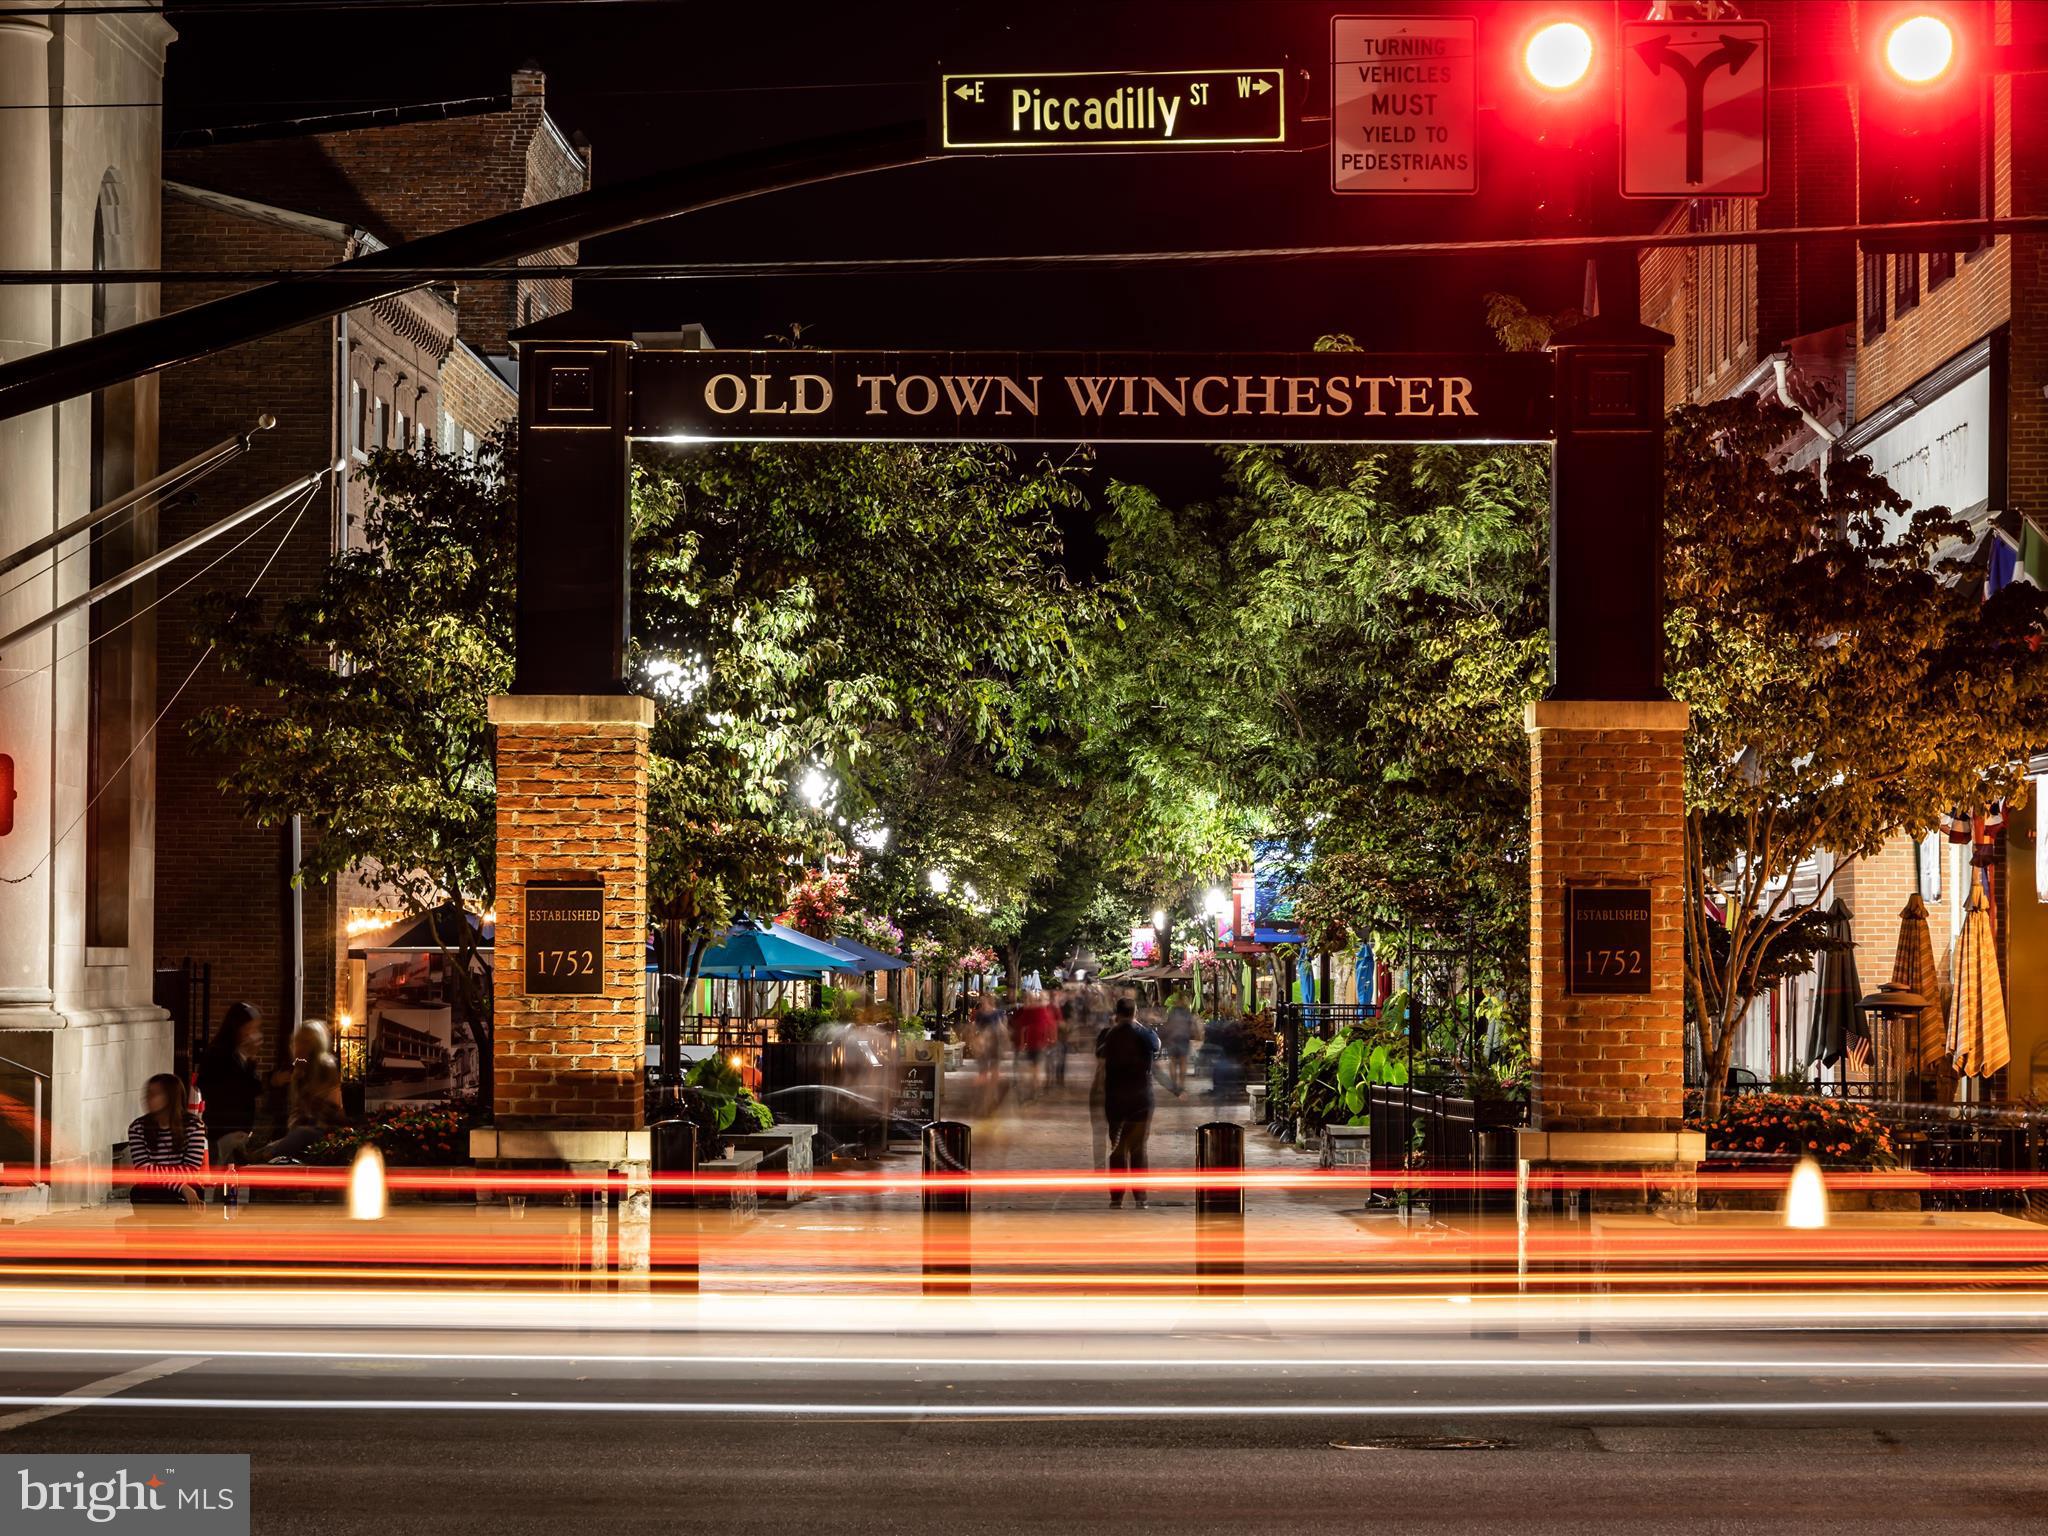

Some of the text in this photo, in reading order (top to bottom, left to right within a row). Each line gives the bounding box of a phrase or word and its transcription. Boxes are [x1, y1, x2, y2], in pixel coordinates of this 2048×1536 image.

[1363, 38, 1446, 56] TURNING
[1358, 66, 1452, 84] VEHICLES
[974, 76, 1251, 137] E Piccadilly ST W
[1371, 94, 1438, 116] MUST
[1362, 126, 1448, 144] YIELD TO
[1341, 153, 1469, 171] PEDESTRIANS
[703, 374, 1479, 417] OLD TOWN WINCHESTER
[529, 910, 601, 921] ESTABLISHED
[1576, 909, 1648, 920] ESTABLISHED
[538, 950, 594, 976] 1752
[1585, 950, 1642, 976] 1752
